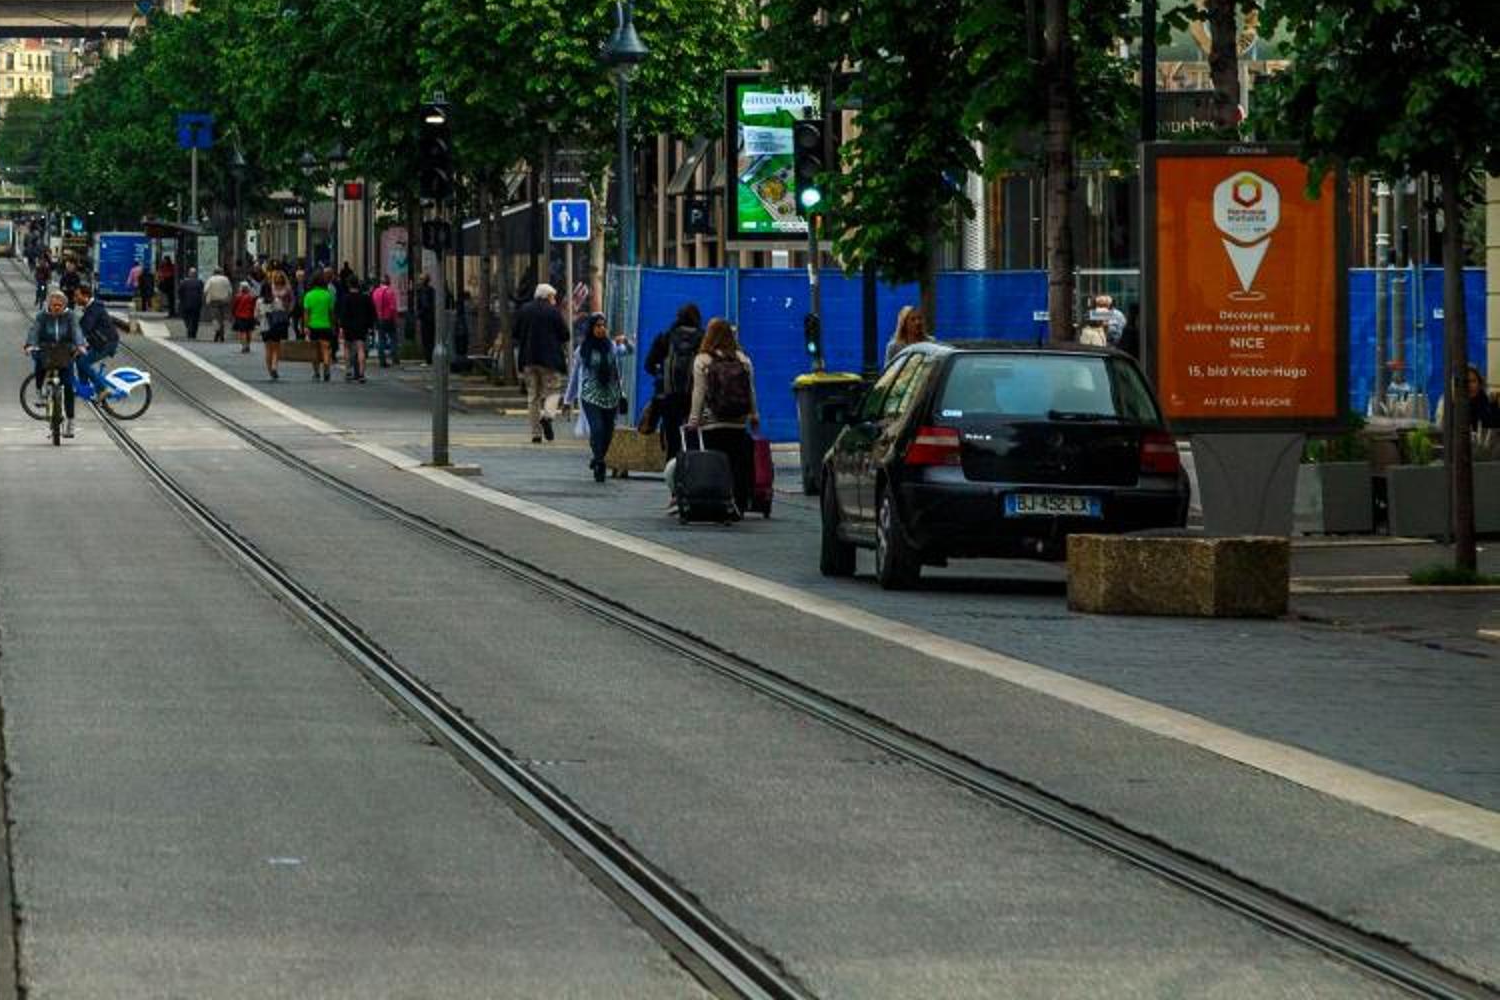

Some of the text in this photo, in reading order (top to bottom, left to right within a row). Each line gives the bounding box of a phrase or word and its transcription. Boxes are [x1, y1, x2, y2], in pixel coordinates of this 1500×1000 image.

[1219, 310, 1275, 320] Découvrez
[1229, 337, 1266, 349] NICE
[1187, 365, 1307, 378] 15, bld Victor-Hugo
[1219, 397, 1238, 407] FEU
[1251, 397, 1291, 407] GAUCHE
